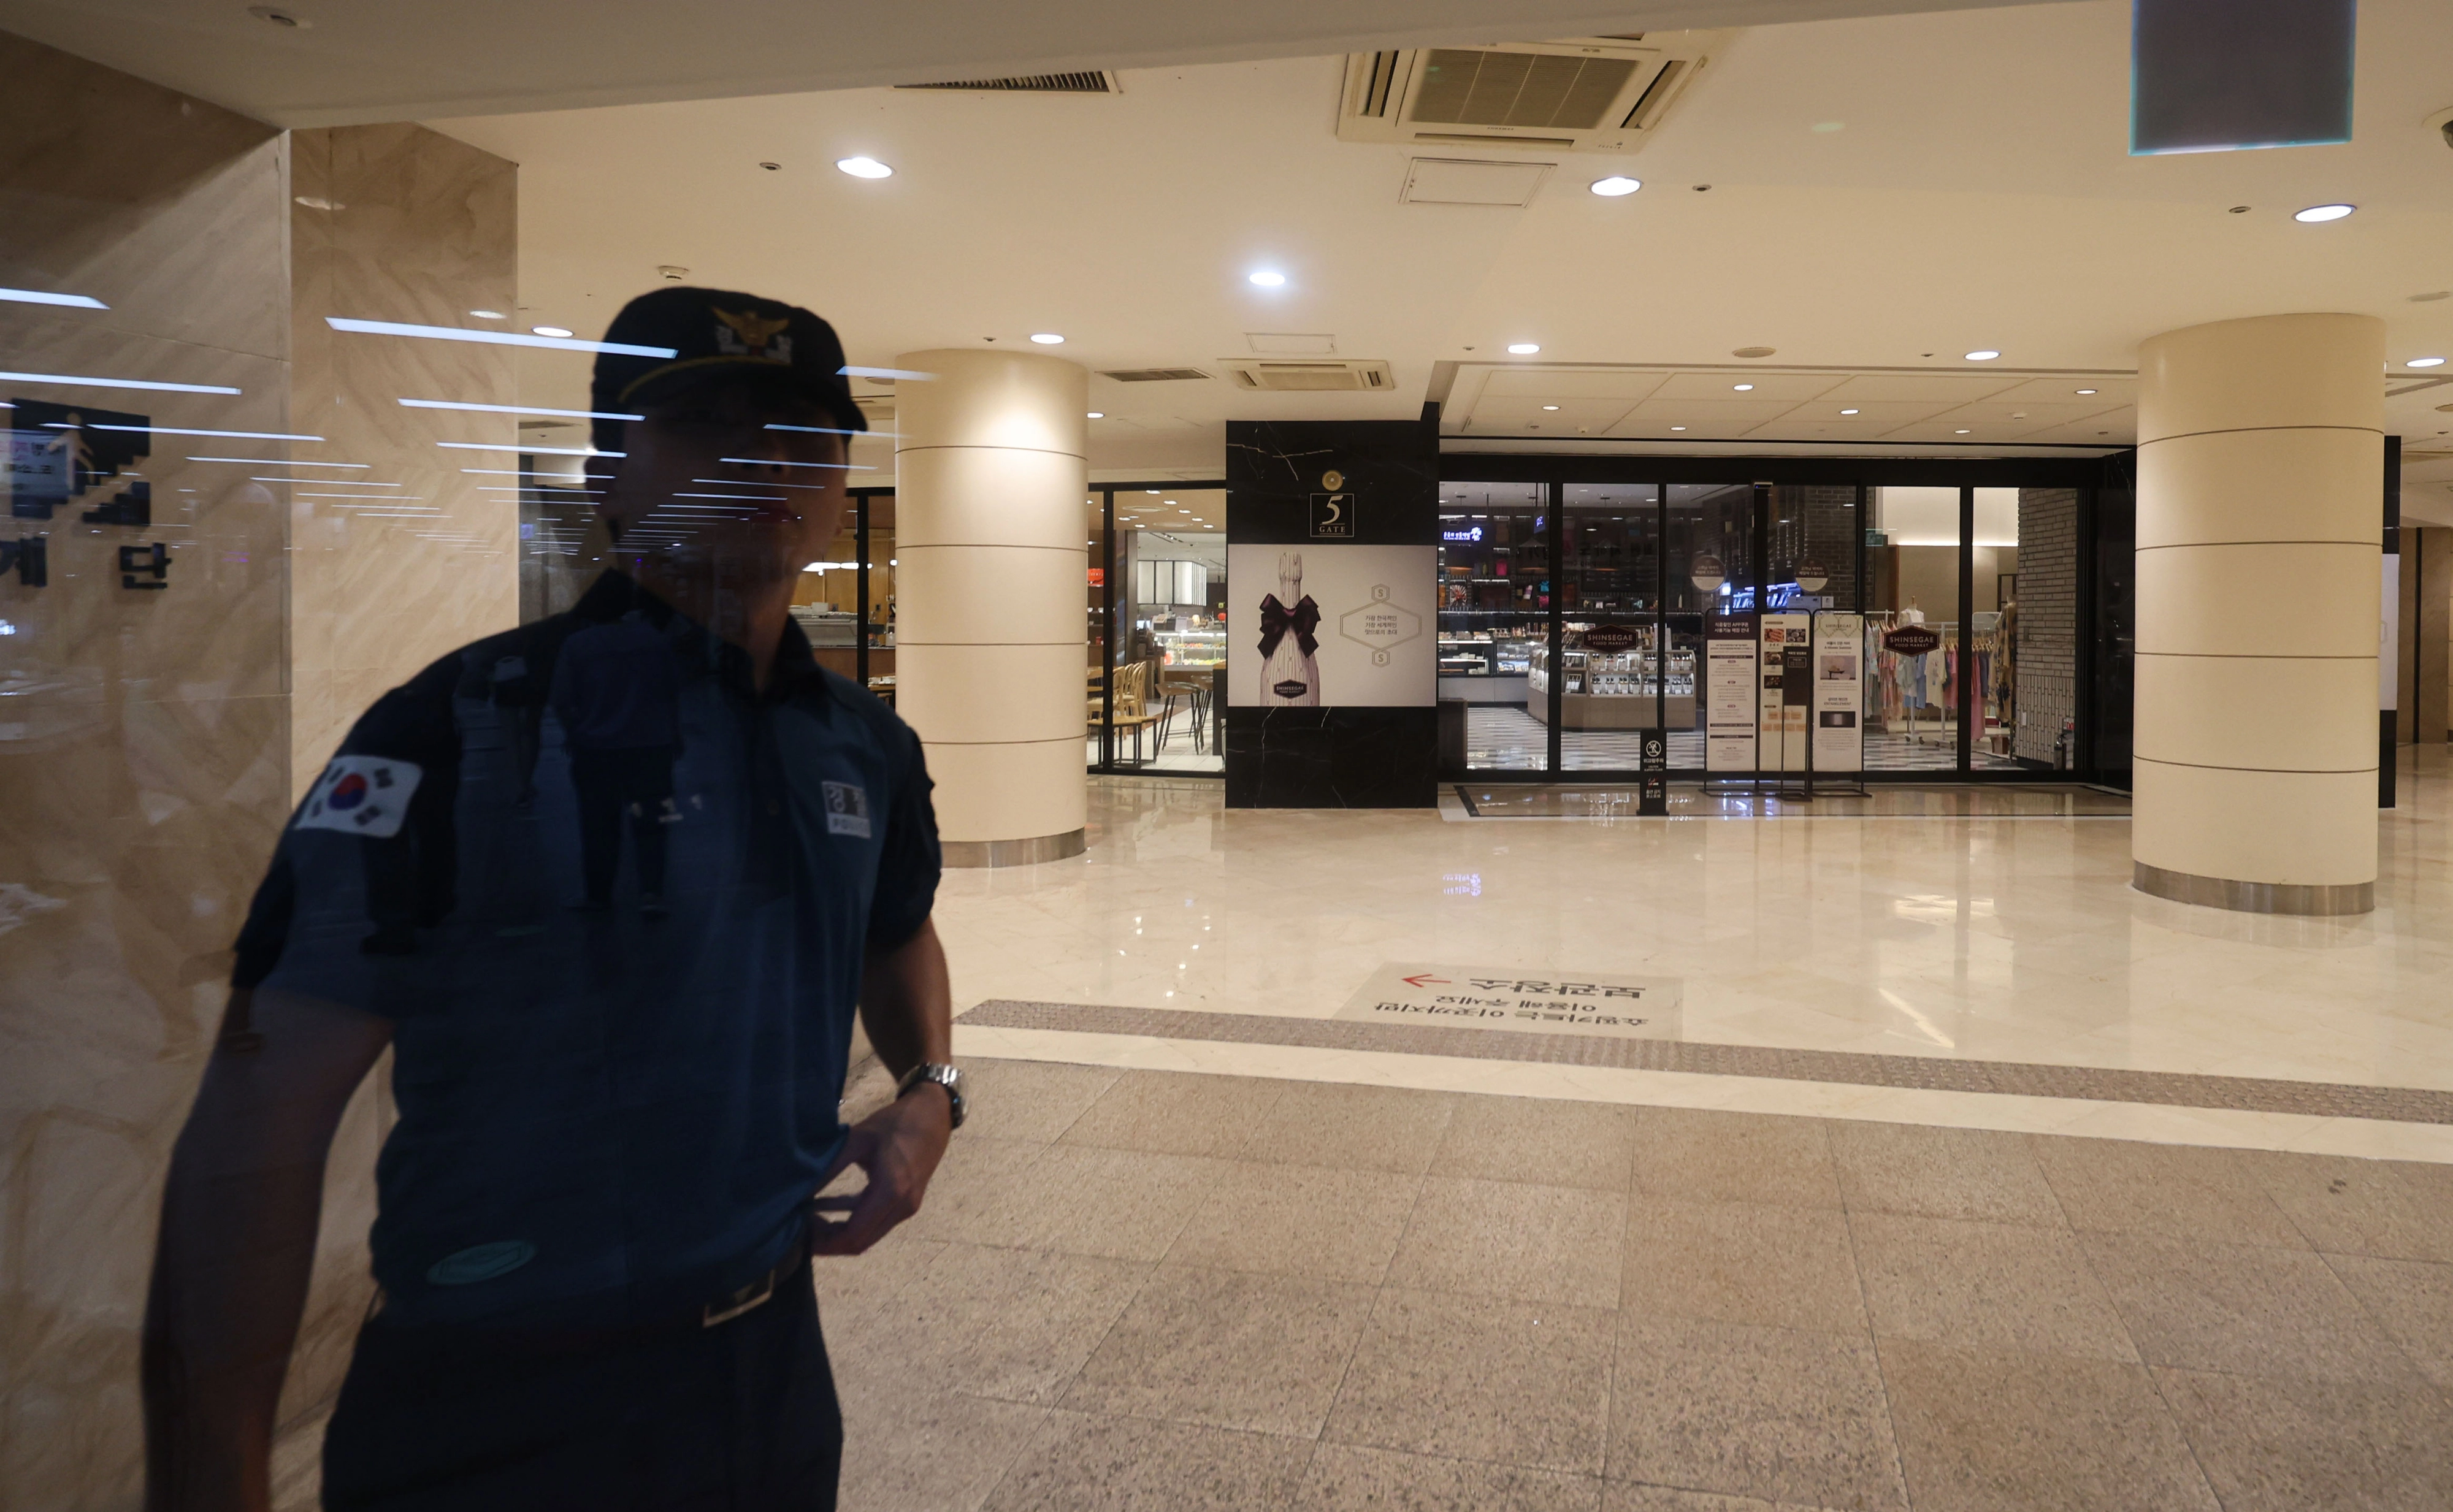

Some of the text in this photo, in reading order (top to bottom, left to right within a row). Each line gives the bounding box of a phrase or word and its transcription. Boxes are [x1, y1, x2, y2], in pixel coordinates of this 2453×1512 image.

[1322, 495, 1343, 525] 5
[1469, 978, 1646, 999] 보관장소
[1374, 1002, 1649, 1026] 쇼핑카트는 이곳까지만
[1436, 995, 1596, 1012] 이용해 주세요
